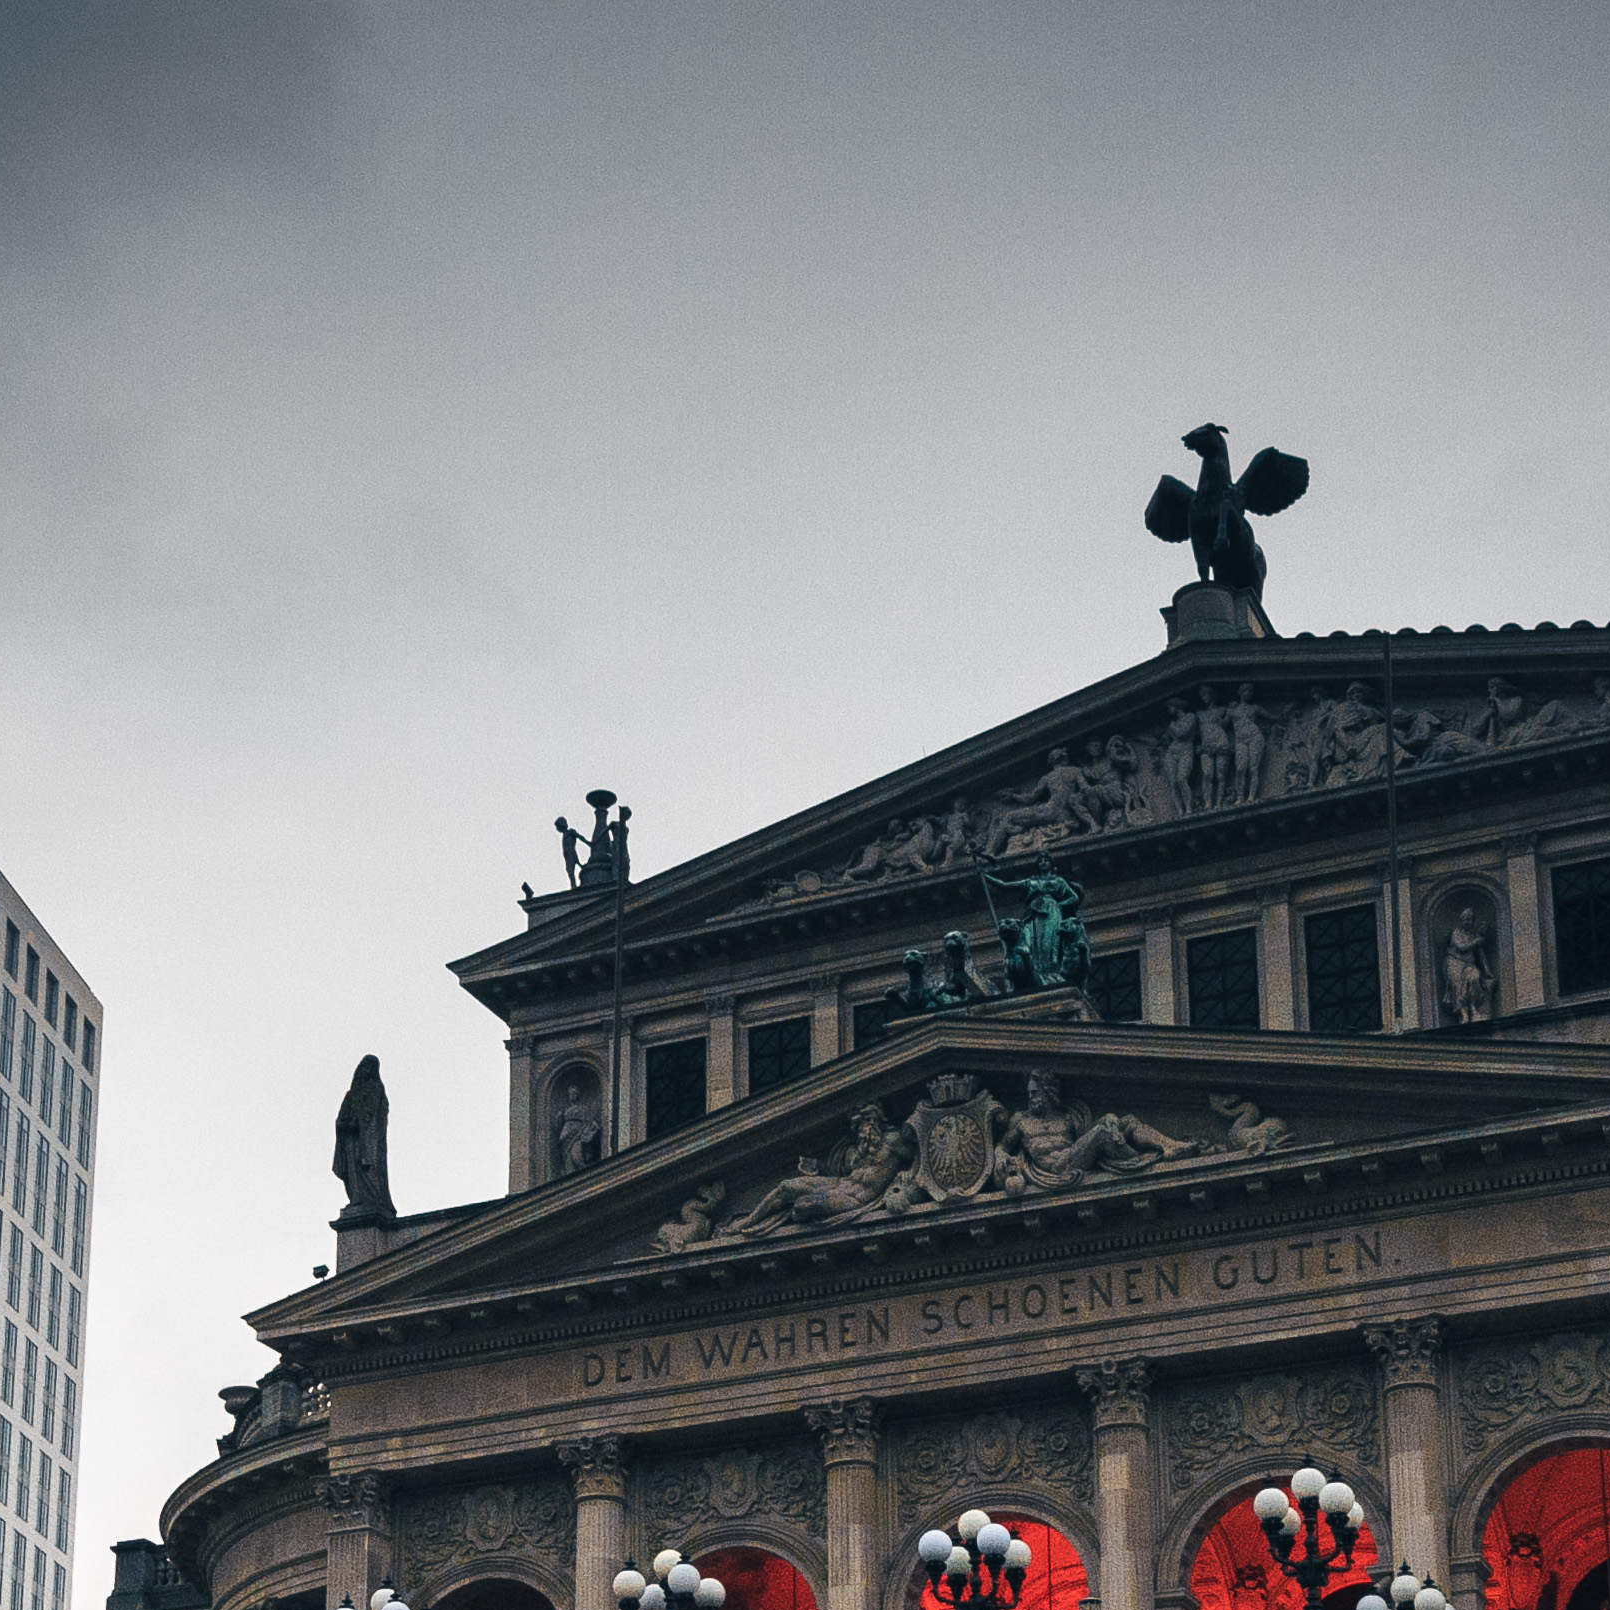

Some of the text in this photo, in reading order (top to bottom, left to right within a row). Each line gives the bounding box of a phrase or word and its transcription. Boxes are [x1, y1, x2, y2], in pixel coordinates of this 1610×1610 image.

[582, 1342, 672, 1387] DEM
[696, 1306, 891, 1370] WAHREN
[921, 1262, 1181, 1335] SCHOENEN
